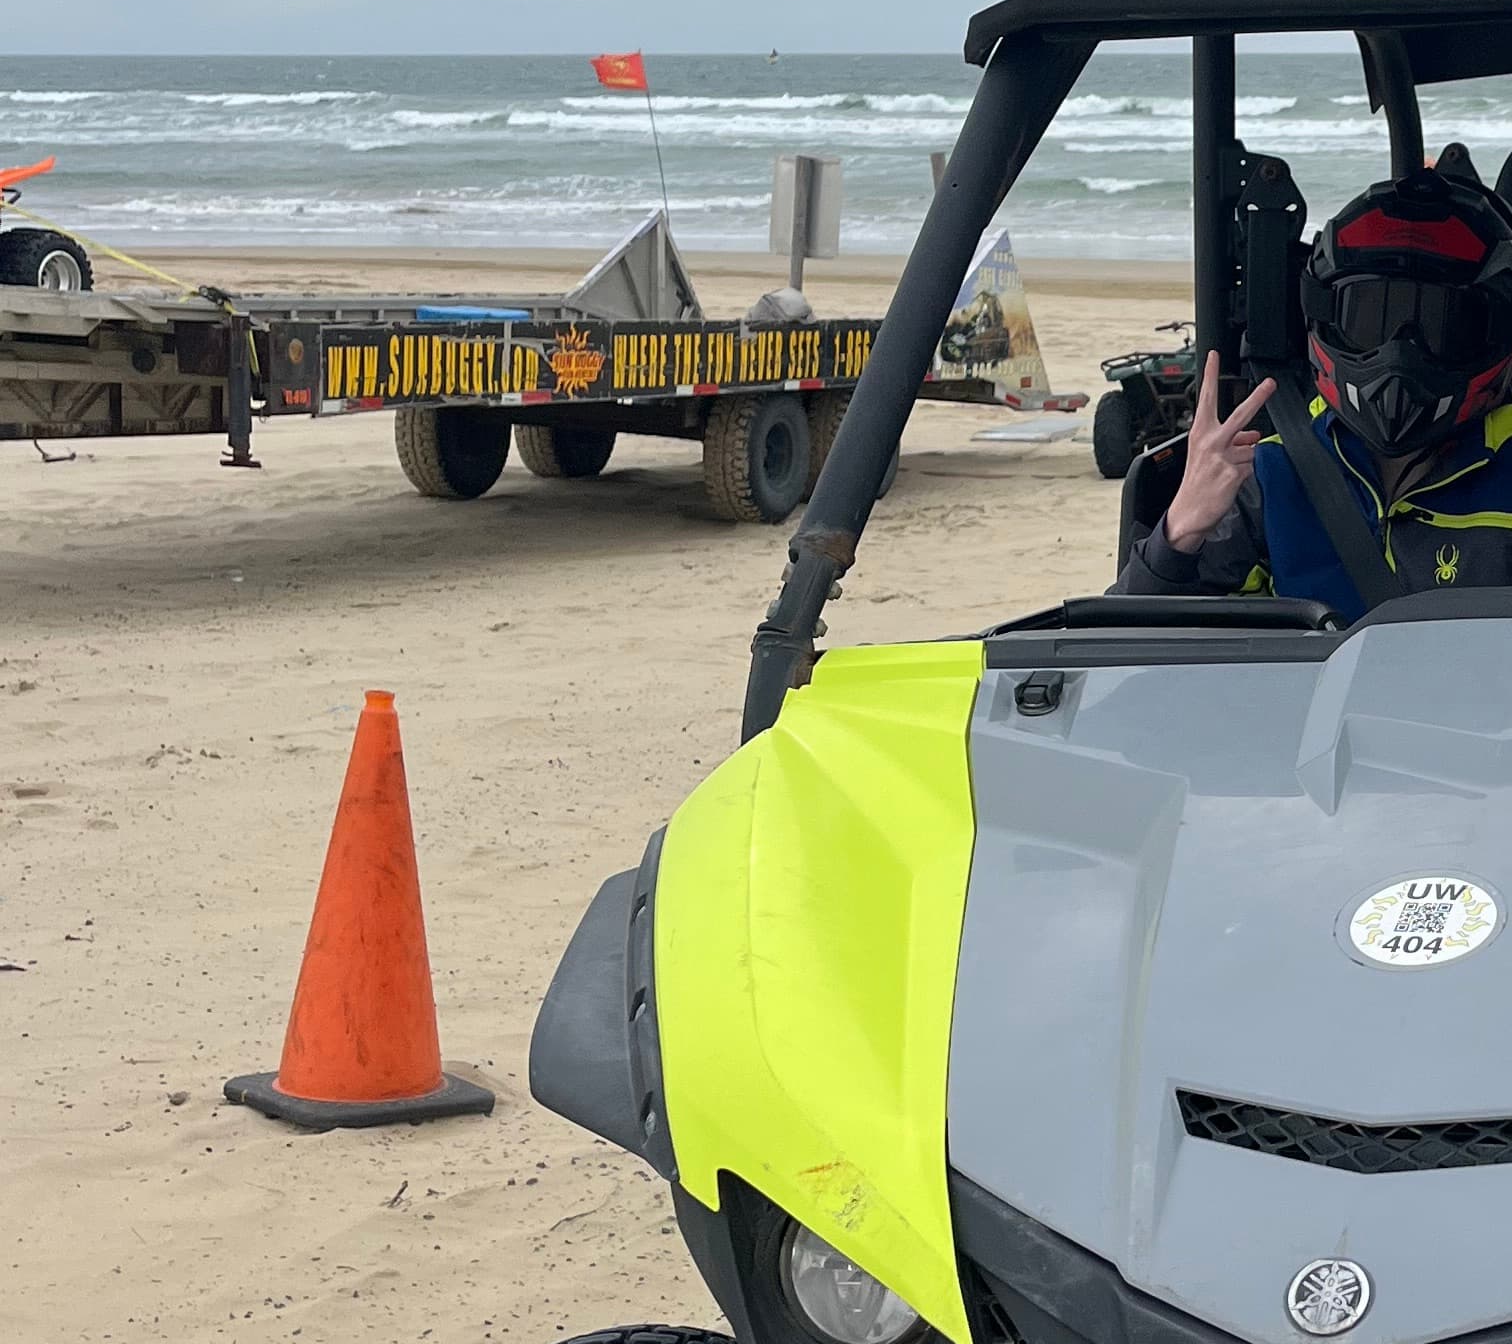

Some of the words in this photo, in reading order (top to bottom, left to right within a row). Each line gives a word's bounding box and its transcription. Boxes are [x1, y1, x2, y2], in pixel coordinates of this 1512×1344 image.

[613, 334, 667, 389] WHERE
[674, 332, 701, 386] THE
[707, 331, 734, 384] FUN
[739, 330, 783, 383] NEVER
[788, 329, 821, 381] SETS
[1407, 883, 1466, 901] UW
[1381, 936, 1443, 955] 404
